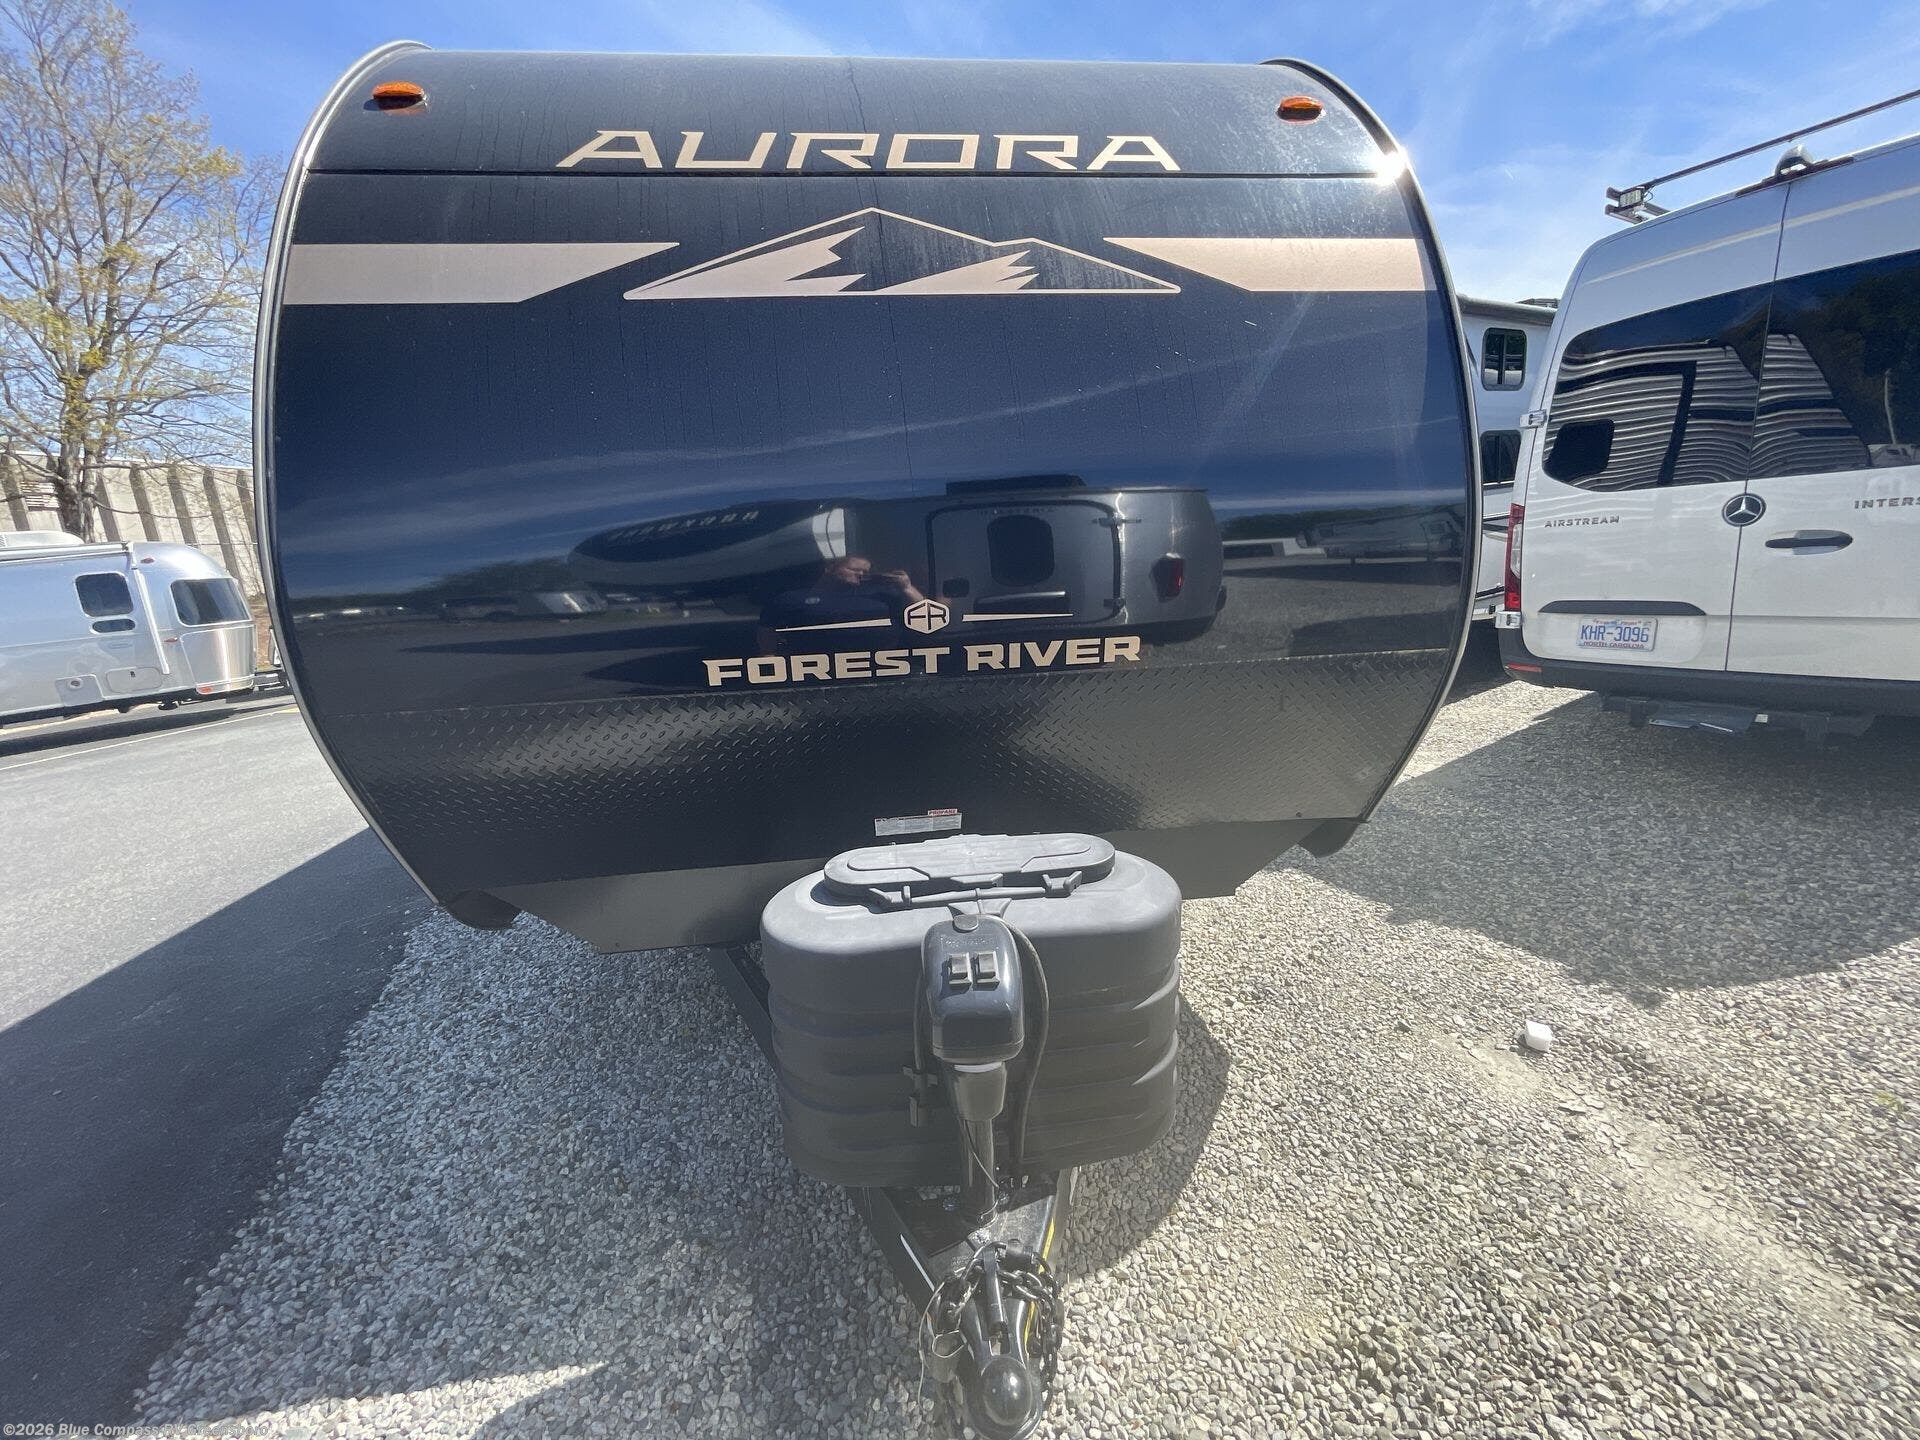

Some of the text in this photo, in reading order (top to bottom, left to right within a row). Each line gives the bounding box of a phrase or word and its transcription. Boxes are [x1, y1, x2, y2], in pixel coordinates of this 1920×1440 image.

[556, 130, 1181, 171] AURORA
[1544, 516, 1619, 528] AIRSTREAM
[1581, 625, 1649, 643] KHR-3096
[702, 635, 1142, 686] FOREST RIVER
